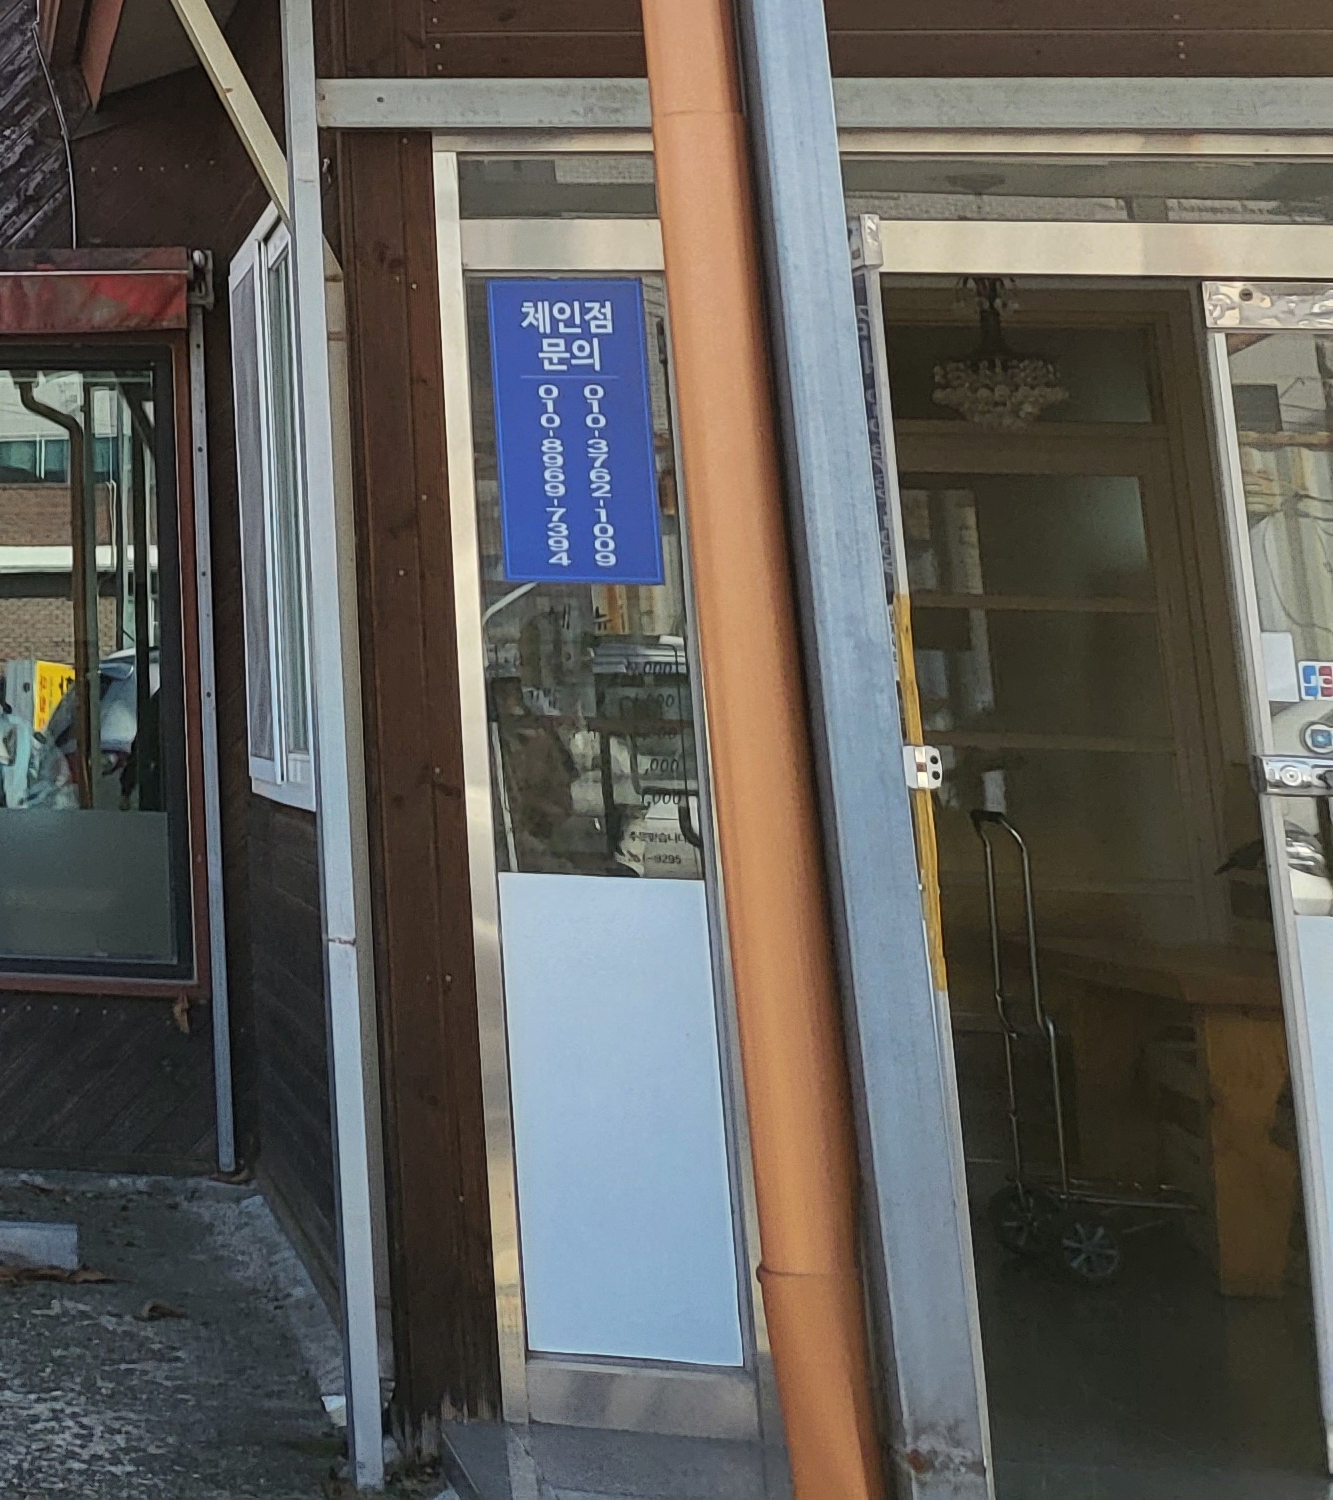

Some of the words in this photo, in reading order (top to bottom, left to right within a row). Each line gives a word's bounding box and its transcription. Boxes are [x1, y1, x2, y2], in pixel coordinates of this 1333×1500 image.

[520, 301, 614, 335] 체인점
[537, 338, 601, 371] 문의
[537, 384, 572, 567] 010-8969-7394
[583, 384, 617, 567] 010-3762-1009
